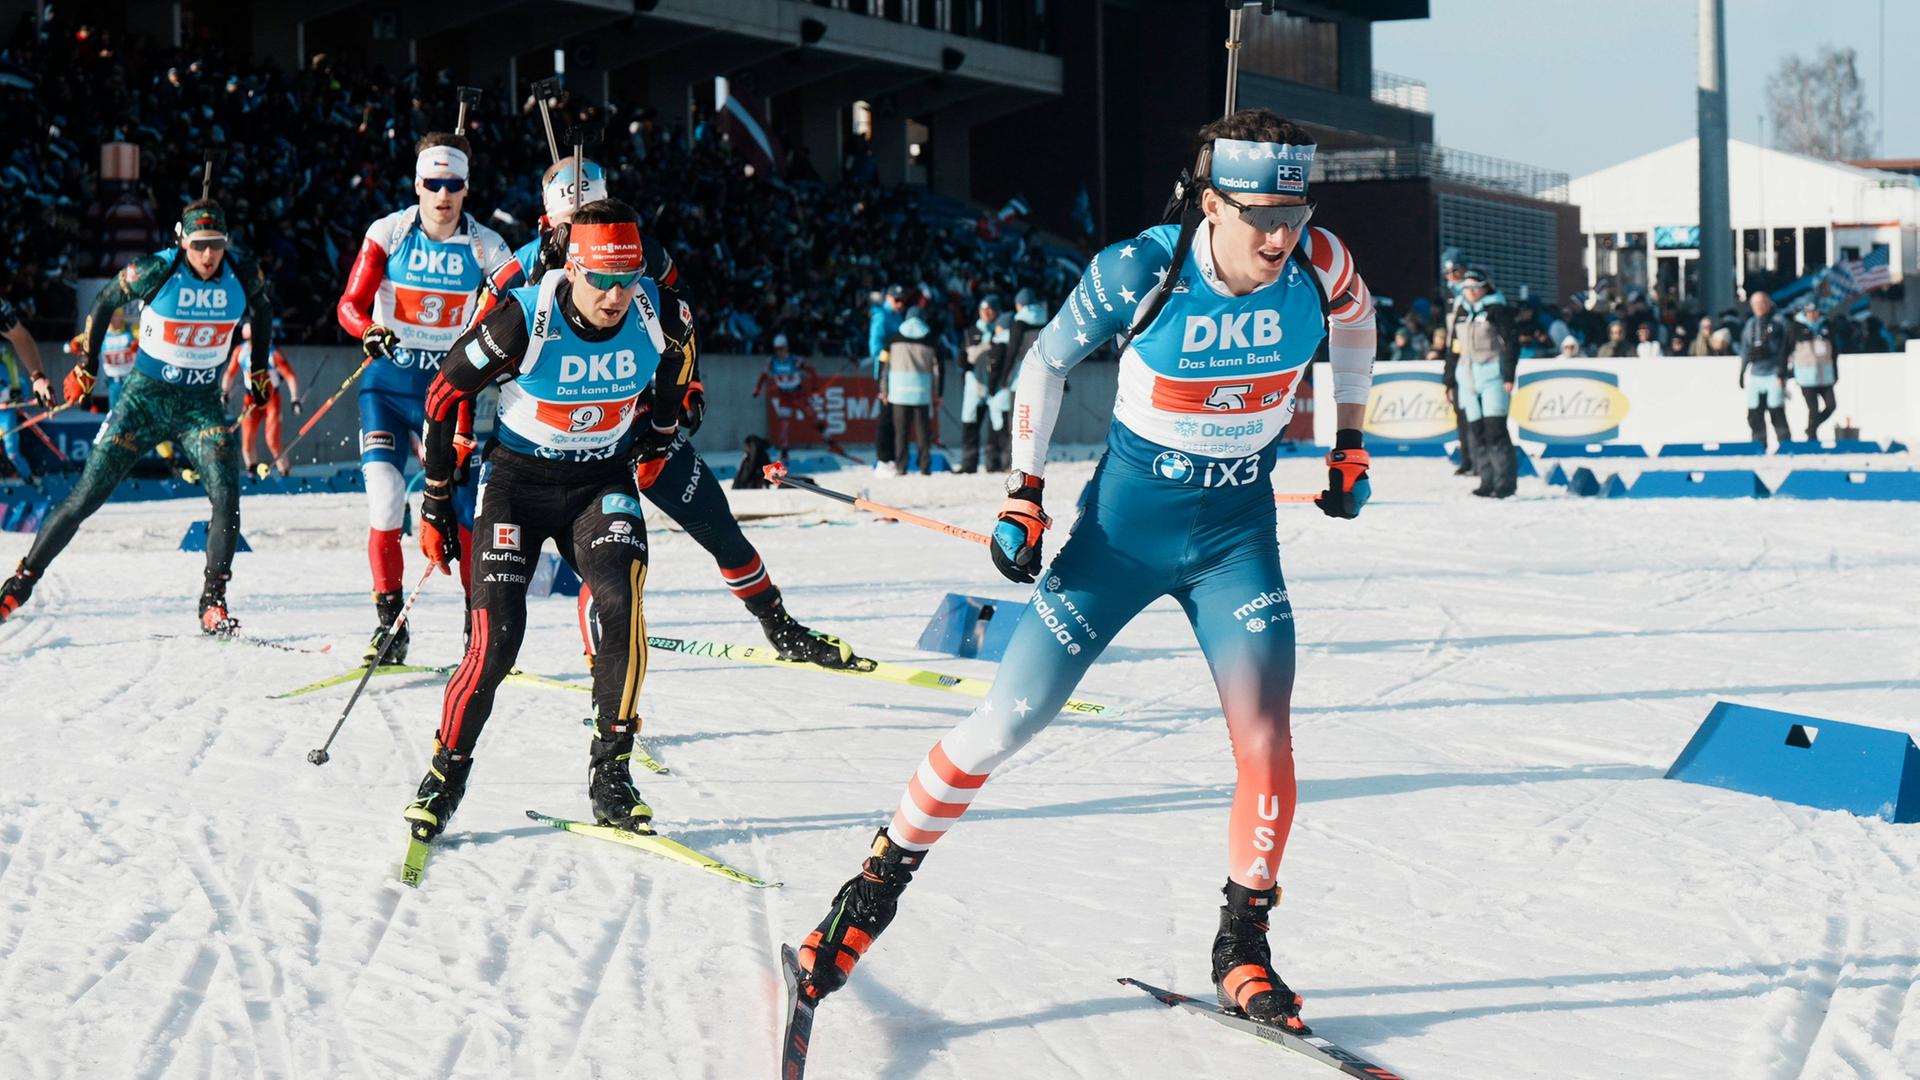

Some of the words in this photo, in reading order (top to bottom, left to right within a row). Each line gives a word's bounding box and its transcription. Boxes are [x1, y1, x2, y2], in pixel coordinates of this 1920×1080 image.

[408, 248, 464, 276] DKB
[178, 287, 228, 308] DKB
[418, 294, 445, 325] 3
[636, 293, 656, 320] JOKA
[175, 326, 216, 347] 18
[534, 310, 548, 339] JOKA
[1181, 308, 1283, 353] DKB
[483, 329, 509, 360] TERREX
[419, 351, 448, 370] iX
[558, 349, 637, 383] DKB
[1178, 358, 1206, 370] Das
[1209, 356, 1243, 368] kann
[1246, 351, 1281, 365] Bank
[186, 368, 216, 385] iX3
[556, 386, 578, 396] Das
[581, 386, 608, 395] kann
[611, 382, 637, 392] Bank
[1203, 383, 1254, 411] 5
[568, 405, 604, 433] 9
[1201, 419, 1264, 440] Otepää
[682, 458, 702, 503] CRAFT
[1203, 454, 1261, 488] iX3
[1032, 589, 1073, 645] maloja
[1057, 594, 1098, 640] ARIENS
[1246, 793, 1279, 880] USA
